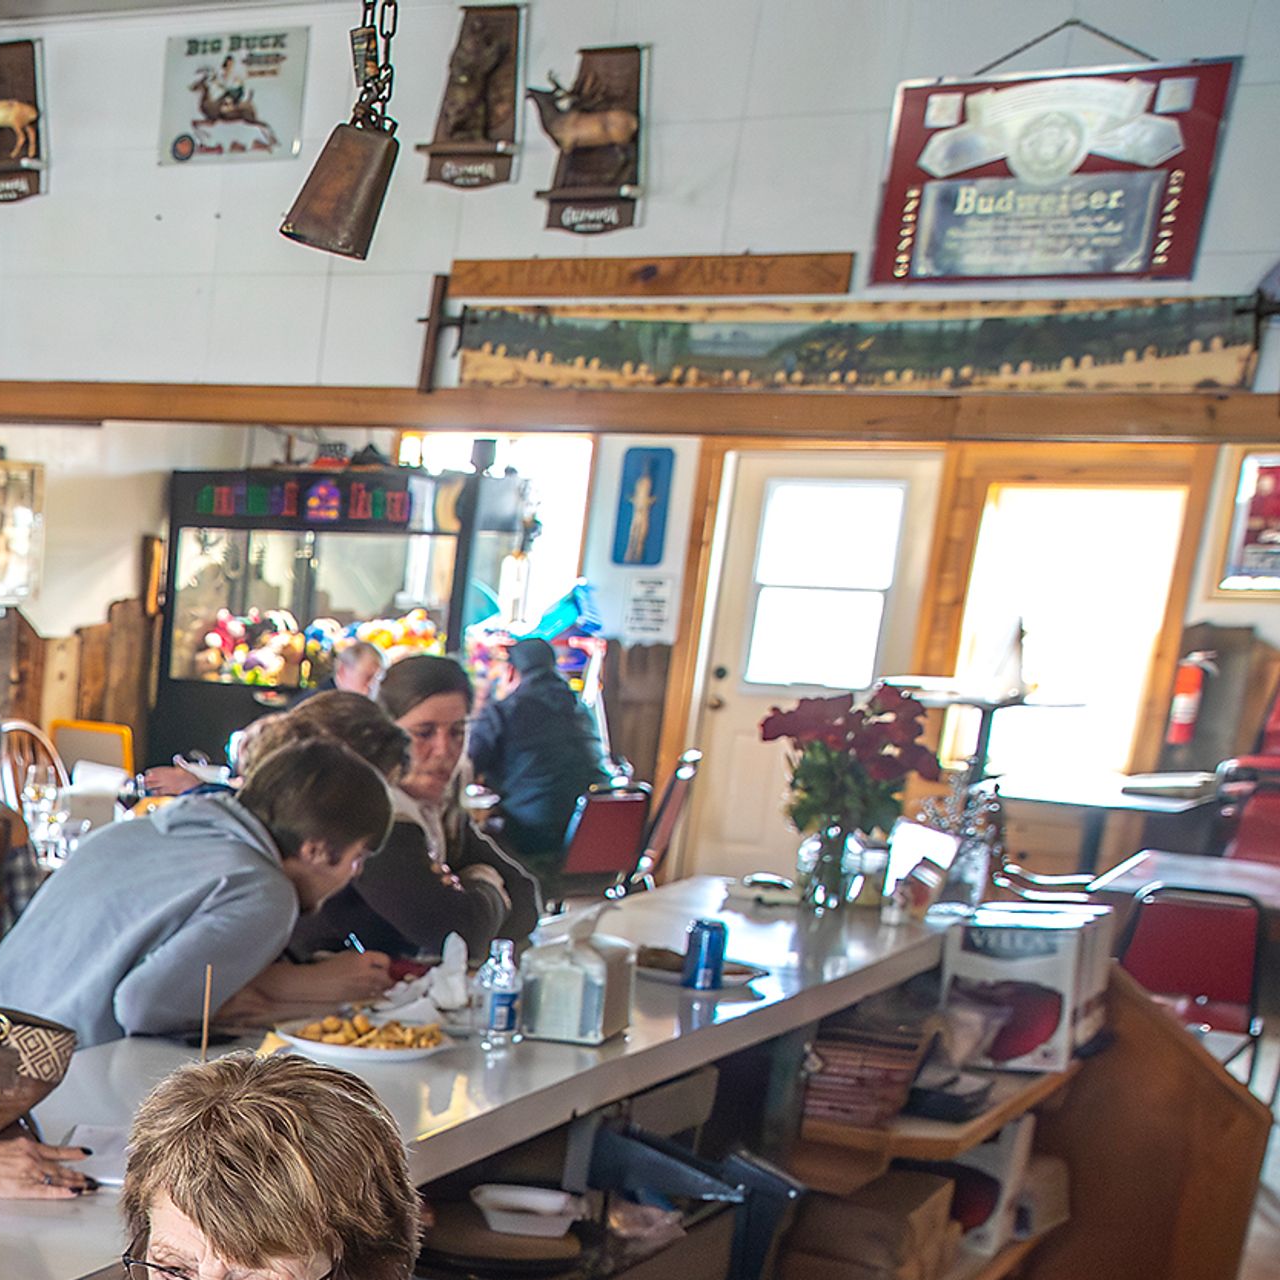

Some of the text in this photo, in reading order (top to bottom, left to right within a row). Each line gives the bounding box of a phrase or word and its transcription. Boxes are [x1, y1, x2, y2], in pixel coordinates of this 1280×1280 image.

[186, 33, 288, 56] BIG BUCK
[953, 185, 1125, 216] Budweiser
